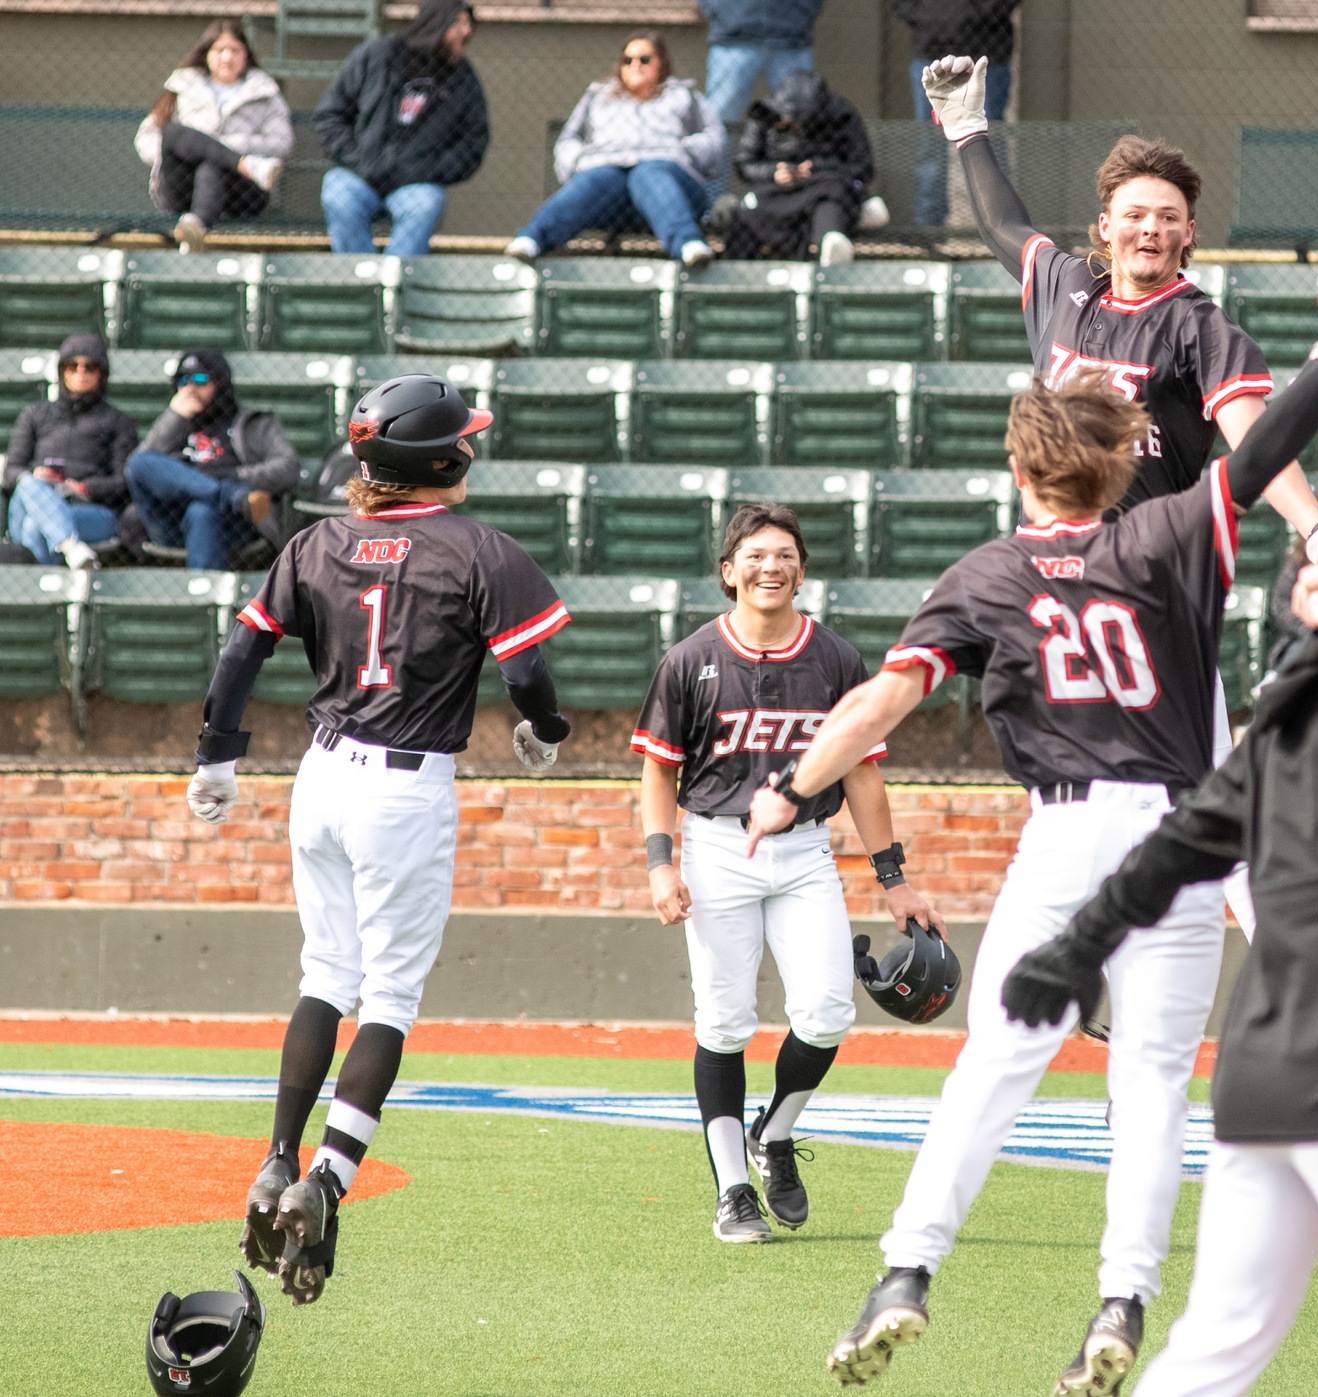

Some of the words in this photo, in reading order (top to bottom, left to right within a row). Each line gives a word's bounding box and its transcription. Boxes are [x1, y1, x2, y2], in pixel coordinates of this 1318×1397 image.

[1044, 341, 1155, 402] JS
[350, 537, 412, 563] NOC
[356, 584, 393, 690] 1
[1026, 592, 1162, 712] 20
[711, 708, 832, 757] JETS
